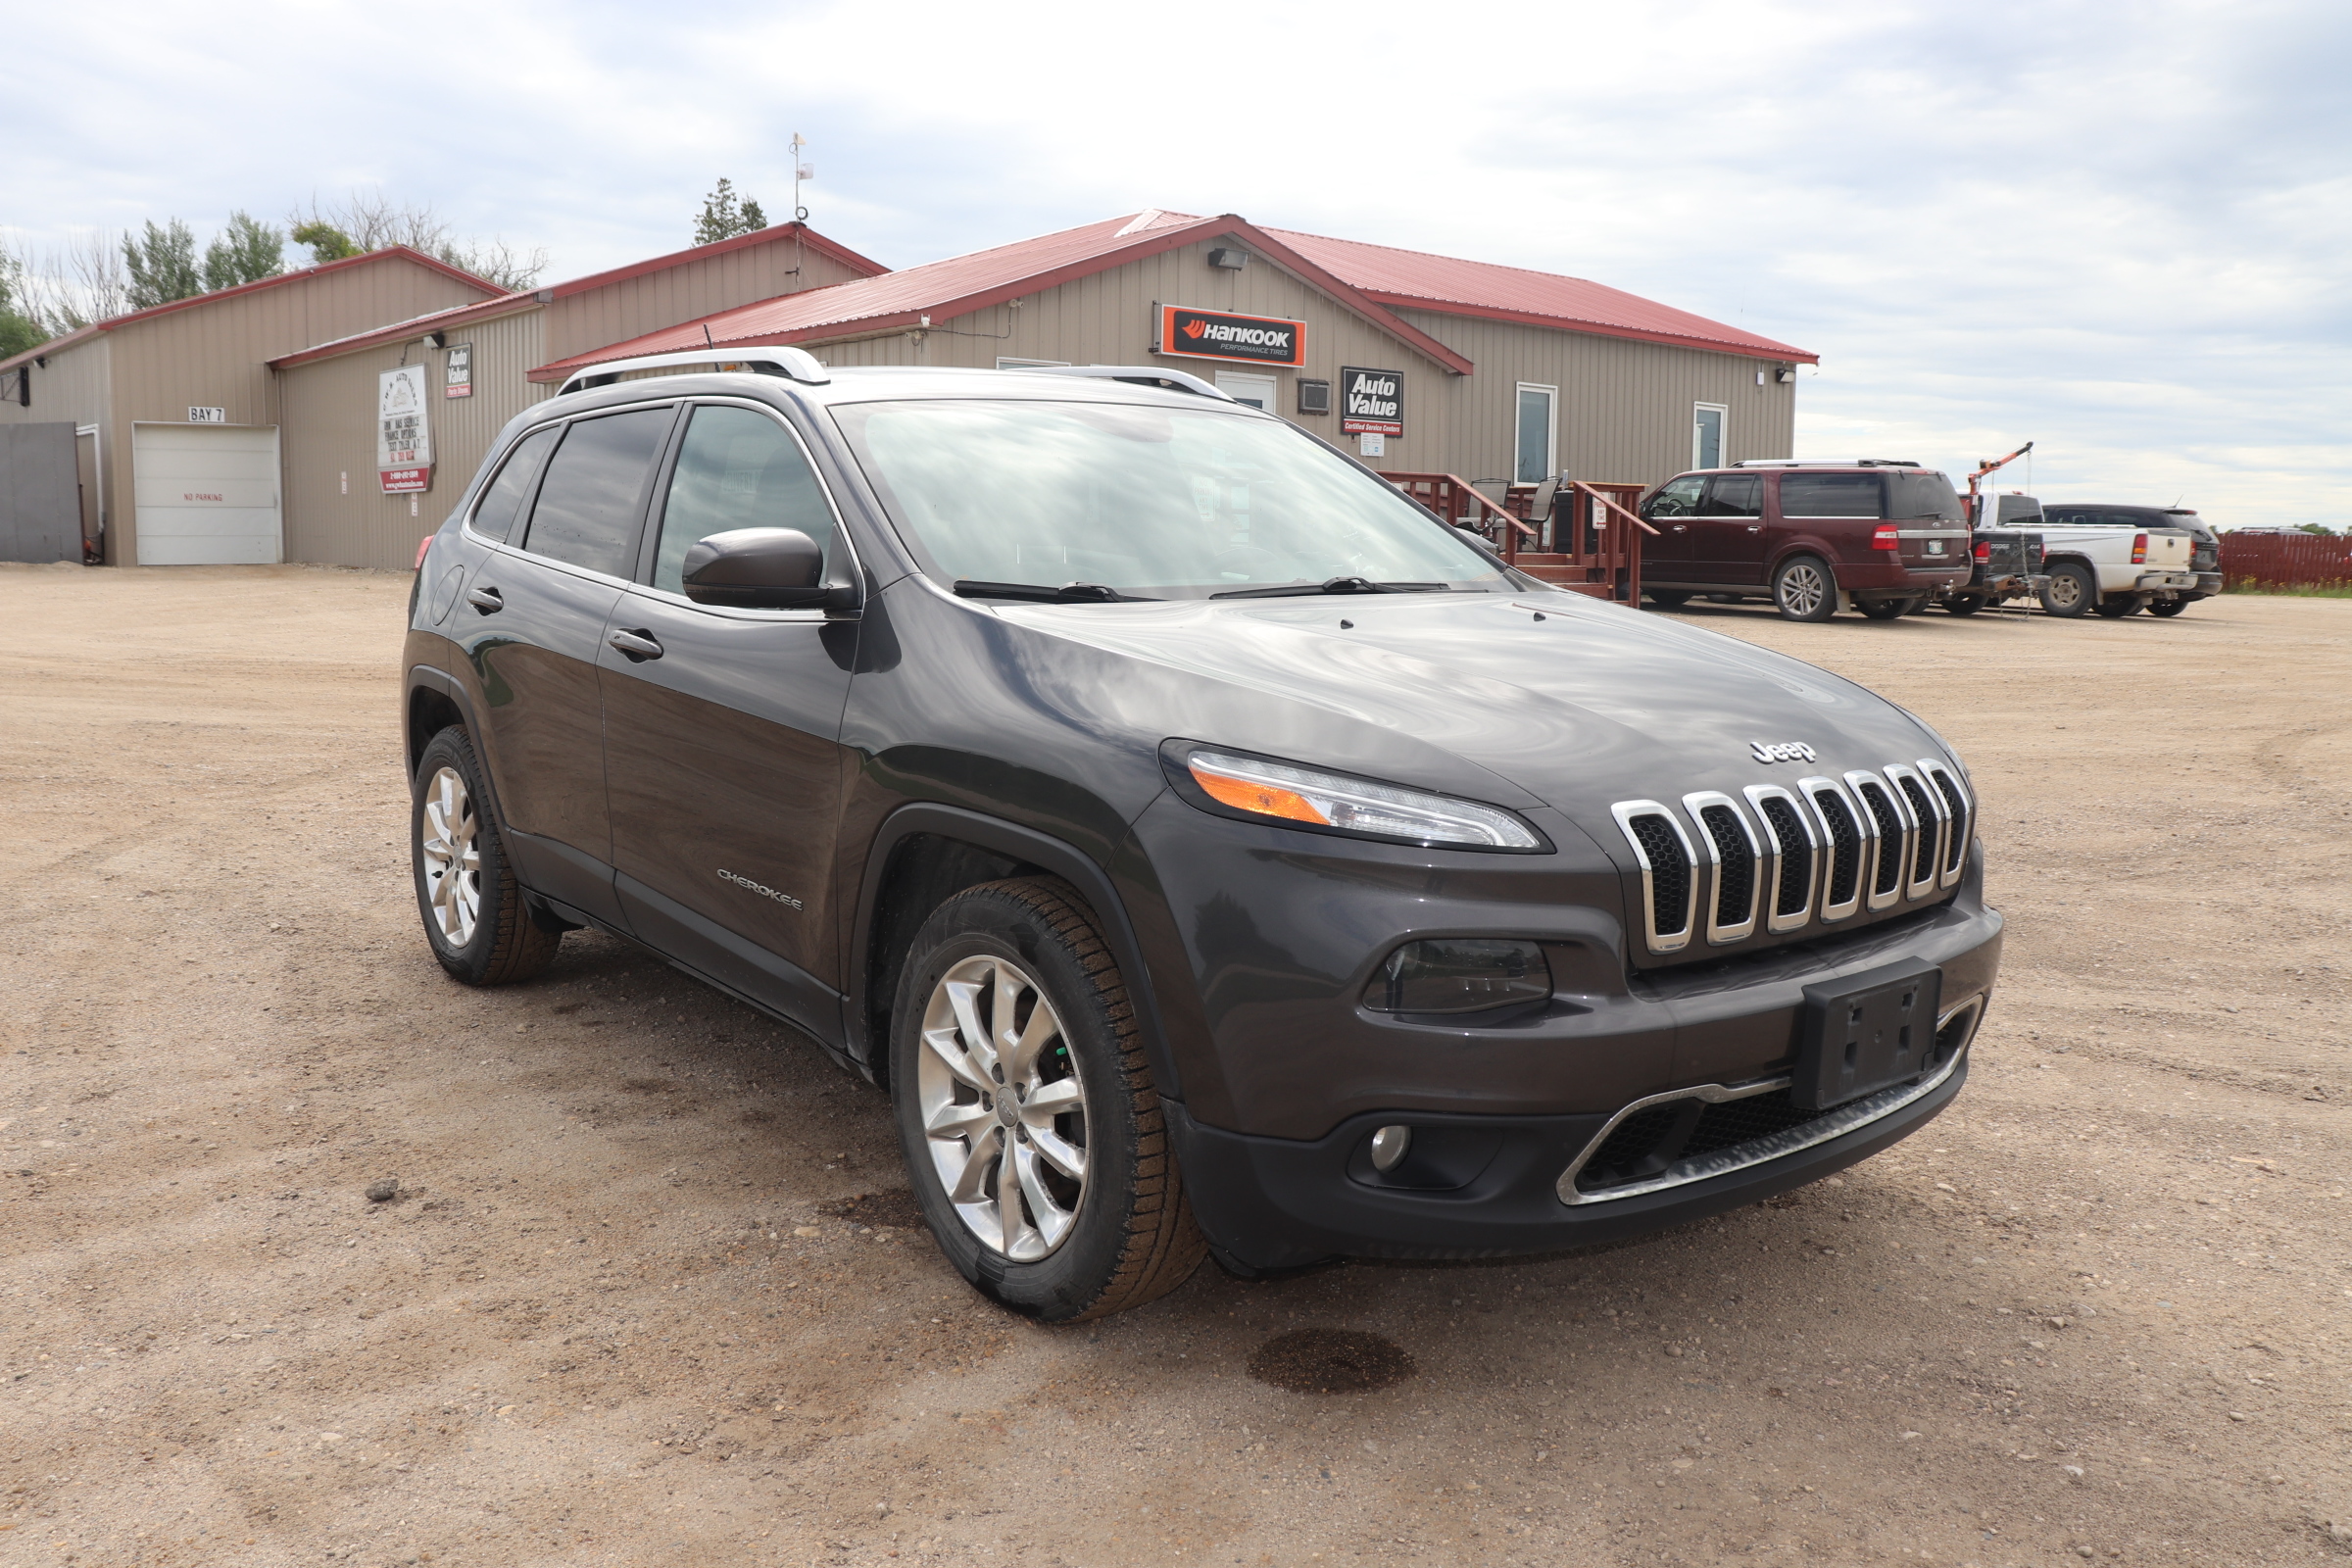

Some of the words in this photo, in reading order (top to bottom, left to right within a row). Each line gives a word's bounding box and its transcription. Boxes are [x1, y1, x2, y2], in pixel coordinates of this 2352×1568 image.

[449, 349, 467, 367] Auto
[1220, 343, 1269, 354] PERFORMANCE
[448, 367, 468, 383] Value
[1351, 373, 1396, 396] Auto
[191, 408, 211, 420] BAY
[216, 409, 221, 421] 7
[1349, 393, 1397, 416] Value
[1748, 741, 1816, 764] Jeep
[716, 868, 805, 911] CHEROKEE
